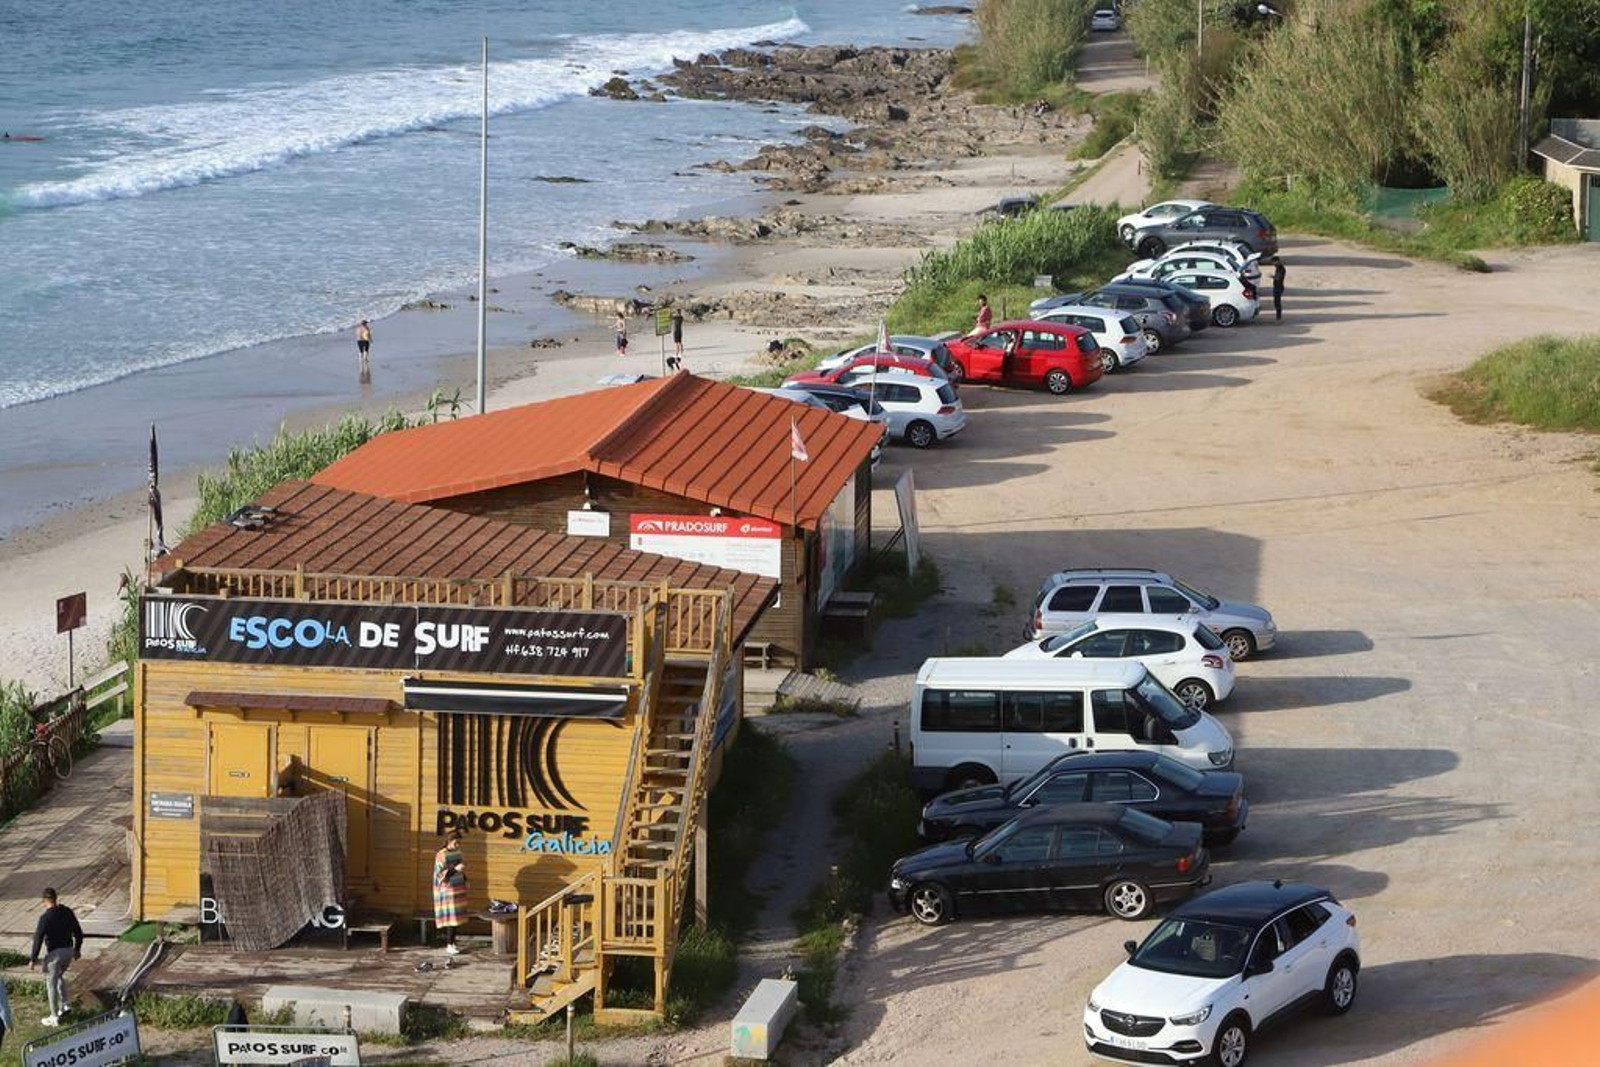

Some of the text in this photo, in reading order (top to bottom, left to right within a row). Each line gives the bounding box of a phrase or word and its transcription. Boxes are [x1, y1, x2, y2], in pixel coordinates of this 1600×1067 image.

[665, 520, 728, 533] PRADOSURF
[230, 616, 490, 655] ESCOLA DE SURF
[504, 627, 610, 640] www.patossurf.com
[546, 645, 569, 657] 724
[571, 647, 590, 658] 917
[526, 814, 590, 837] SURF
[525, 831, 612, 855] Galicia
[78, 1037, 107, 1058] SURF
[281, 1044, 317, 1055] SURF
